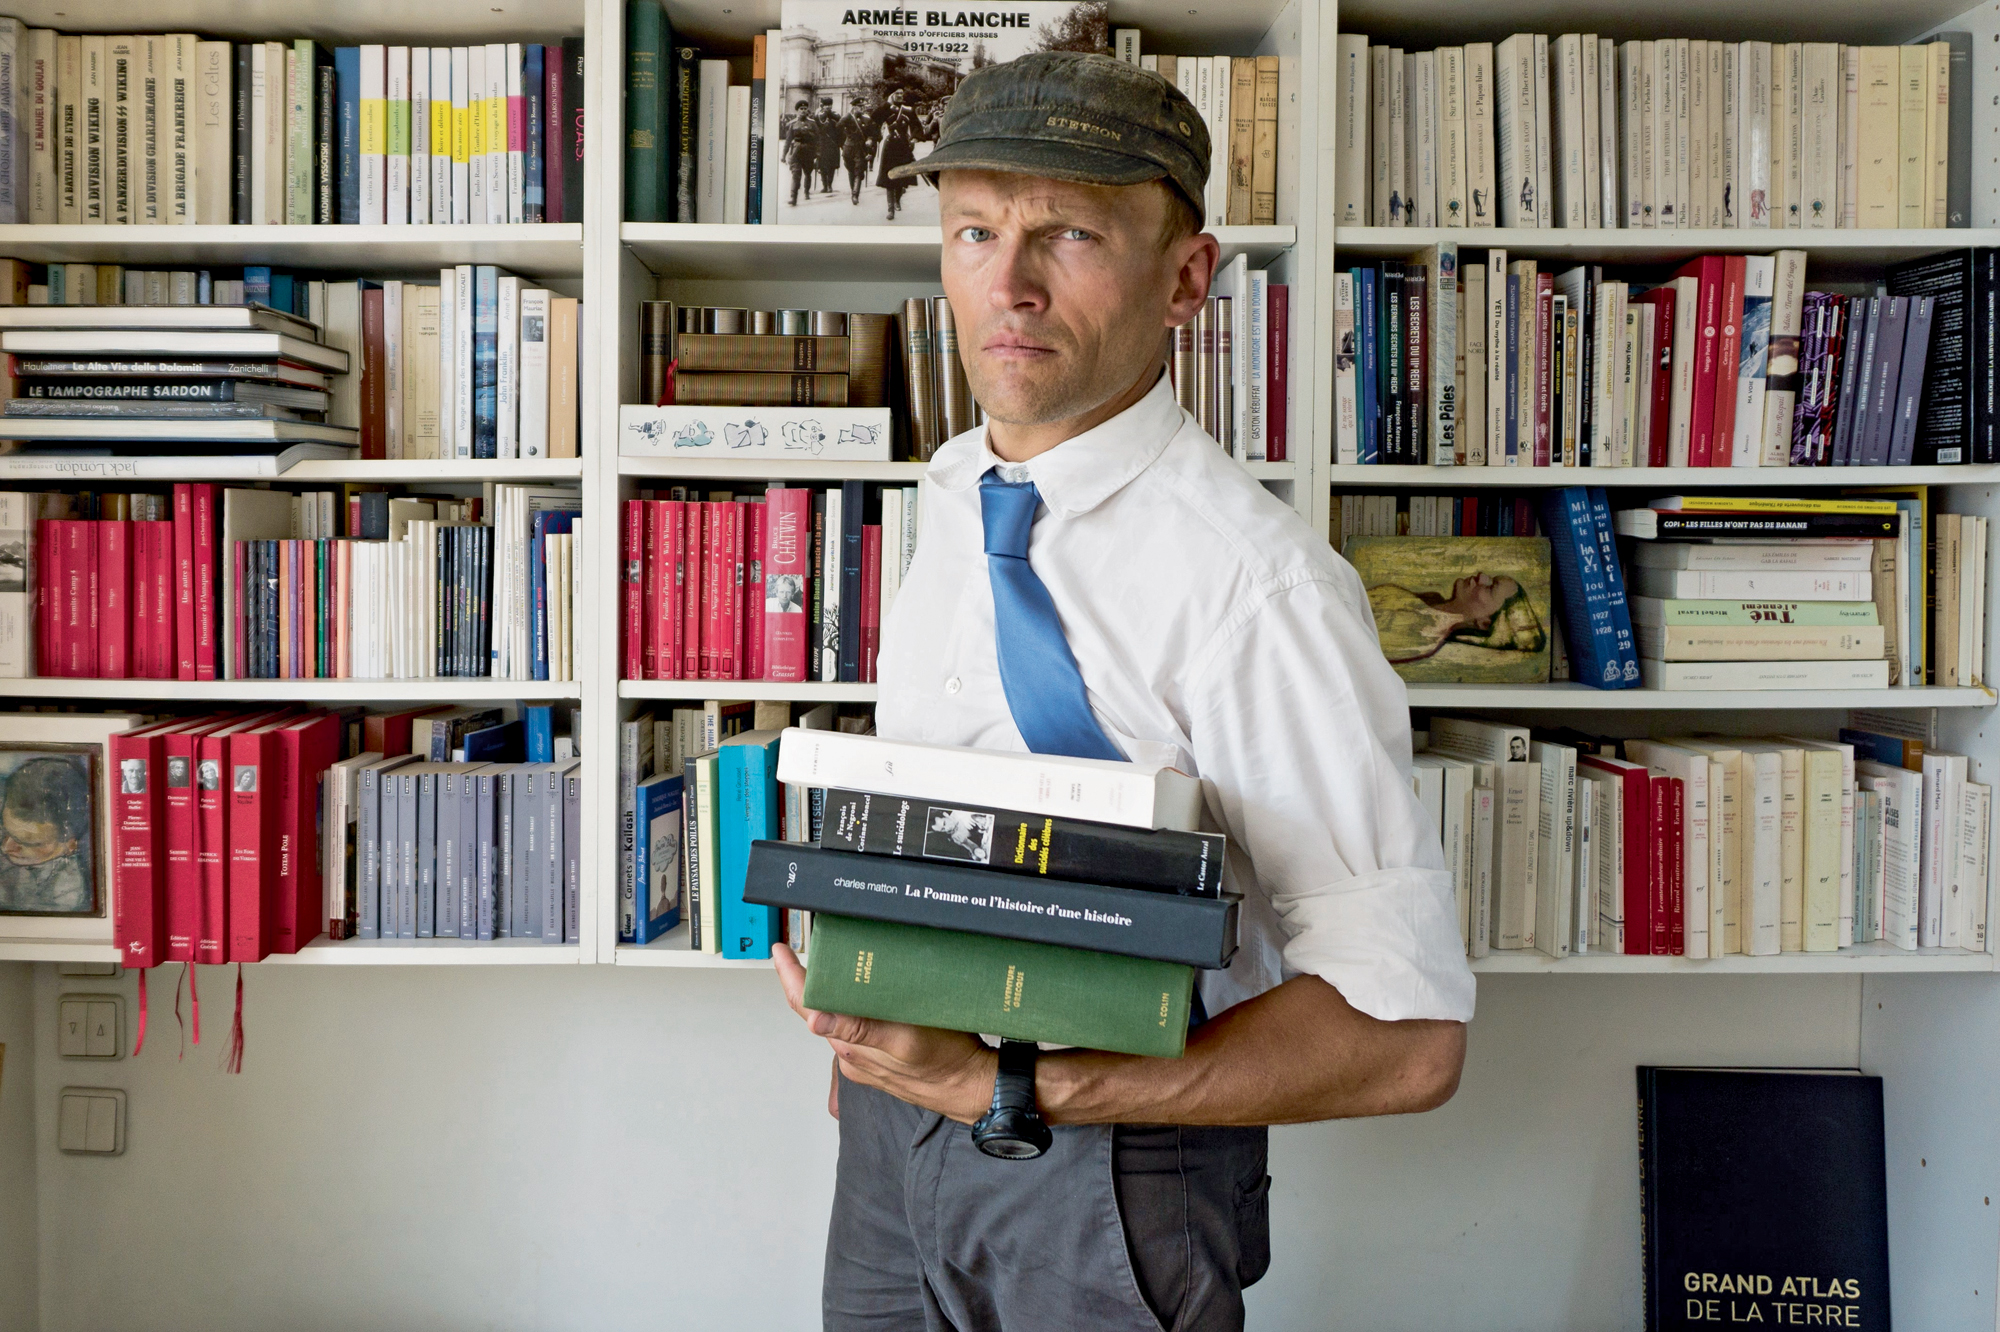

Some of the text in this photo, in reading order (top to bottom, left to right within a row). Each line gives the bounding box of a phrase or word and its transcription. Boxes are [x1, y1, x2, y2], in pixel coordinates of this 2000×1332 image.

[841, 6, 1031, 28] ARMÉE BLANCHE
[873, 30, 916, 38] PORTRAITS
[919, 29, 965, 38] D'OFFICIERS
[903, 42, 968, 53] 1917-1922
[116, 59, 128, 102] WIKING
[204, 50, 220, 128] Les Celtes
[35, 60, 44, 151] LE MANUEL DU GOULAG
[682, 68, 690, 157] RACE ET INTELLIGENCE
[64, 136, 74, 147] DE
[750, 97, 759, 188] REVUE DES DEUX MONDES
[1046, 116, 1123, 141] STETSON
[88, 97, 100, 218] LA DIVISION WIKING
[145, 77, 157, 218] LA DIVISION CHARLEMAGNE
[174, 78, 186, 215] LA BRIGADE FRANKREICH
[64, 150, 74, 193] BATAILLE
[116, 118, 128, 212] PANZERDIVISION
[321, 143, 329, 222] VLADIMIR VYSSOTSKI
[64, 195, 74, 207] LA
[1410, 297, 1420, 310] LES
[1410, 312, 1420, 343] SECRETS
[23, 362, 67, 371] Hauleitner
[72, 361, 202, 372] Le Alte Vie delle Dolomiti
[1249, 278, 1260, 439] GASTON RÉBUFFAT LA MONTAGNE EST MON DOMAINE
[1410, 345, 1420, 356] DU
[228, 363, 268, 373] Zanichelli
[499, 351, 508, 404] John Franklin
[1410, 371, 1420, 390] REICH
[29, 385, 211, 397] LE TAMPOGRAPHE SARDON
[1438, 385, 1455, 447] Les Pôles
[1775, 394, 1786, 439] Jean Raspail
[55, 460, 138, 475] Jack London
[774, 511, 797, 563] CHATWIN
[814, 512, 823, 530] plume
[1765, 521, 1775, 529] DE
[1776, 521, 1808, 529] BANANE
[70, 575, 78, 595] Camp
[814, 569, 821, 577] Le
[70, 597, 78, 625] Yosemite
[200, 604, 207, 612] de
[813, 578, 821, 623] Antoine Blondin
[1750, 609, 1795, 624] Tué
[200, 614, 208, 645] Prisonnier
[812, 743, 820, 775] GALLIMARD
[836, 805, 847, 836] François
[845, 802, 857, 842] de Negroni
[858, 795, 871, 852] Corinne Moncel
[893, 800, 909, 856] Le suicidologe
[280, 834, 289, 876] TOTEM POLE
[624, 811, 634, 899] Carnets du Kailash
[1014, 823, 1027, 864] Dictionnaire
[1028, 838, 1038, 851] des
[1038, 818, 1052, 874] suicidés célèbres
[688, 821, 698, 902] LE PAYSAN DES POILUS
[1197, 841, 1209, 890] Le Castor Astral
[834, 876, 898, 893] charles matton
[905, 884, 1132, 926] La Pomme ou l'histoire d'une histoire
[624, 914, 633, 934] Glénat
[854, 950, 865, 983] PIERRE
[1003, 965, 1015, 1012] L'AVENTURE
[1013, 971, 1024, 1008] GRECQUE
[1158, 992, 1169, 1028] A. COLIN
[1684, 1272, 1861, 1299] GRAND ATLAS
[1687, 1299, 1861, 1327] DE LA TERRE
